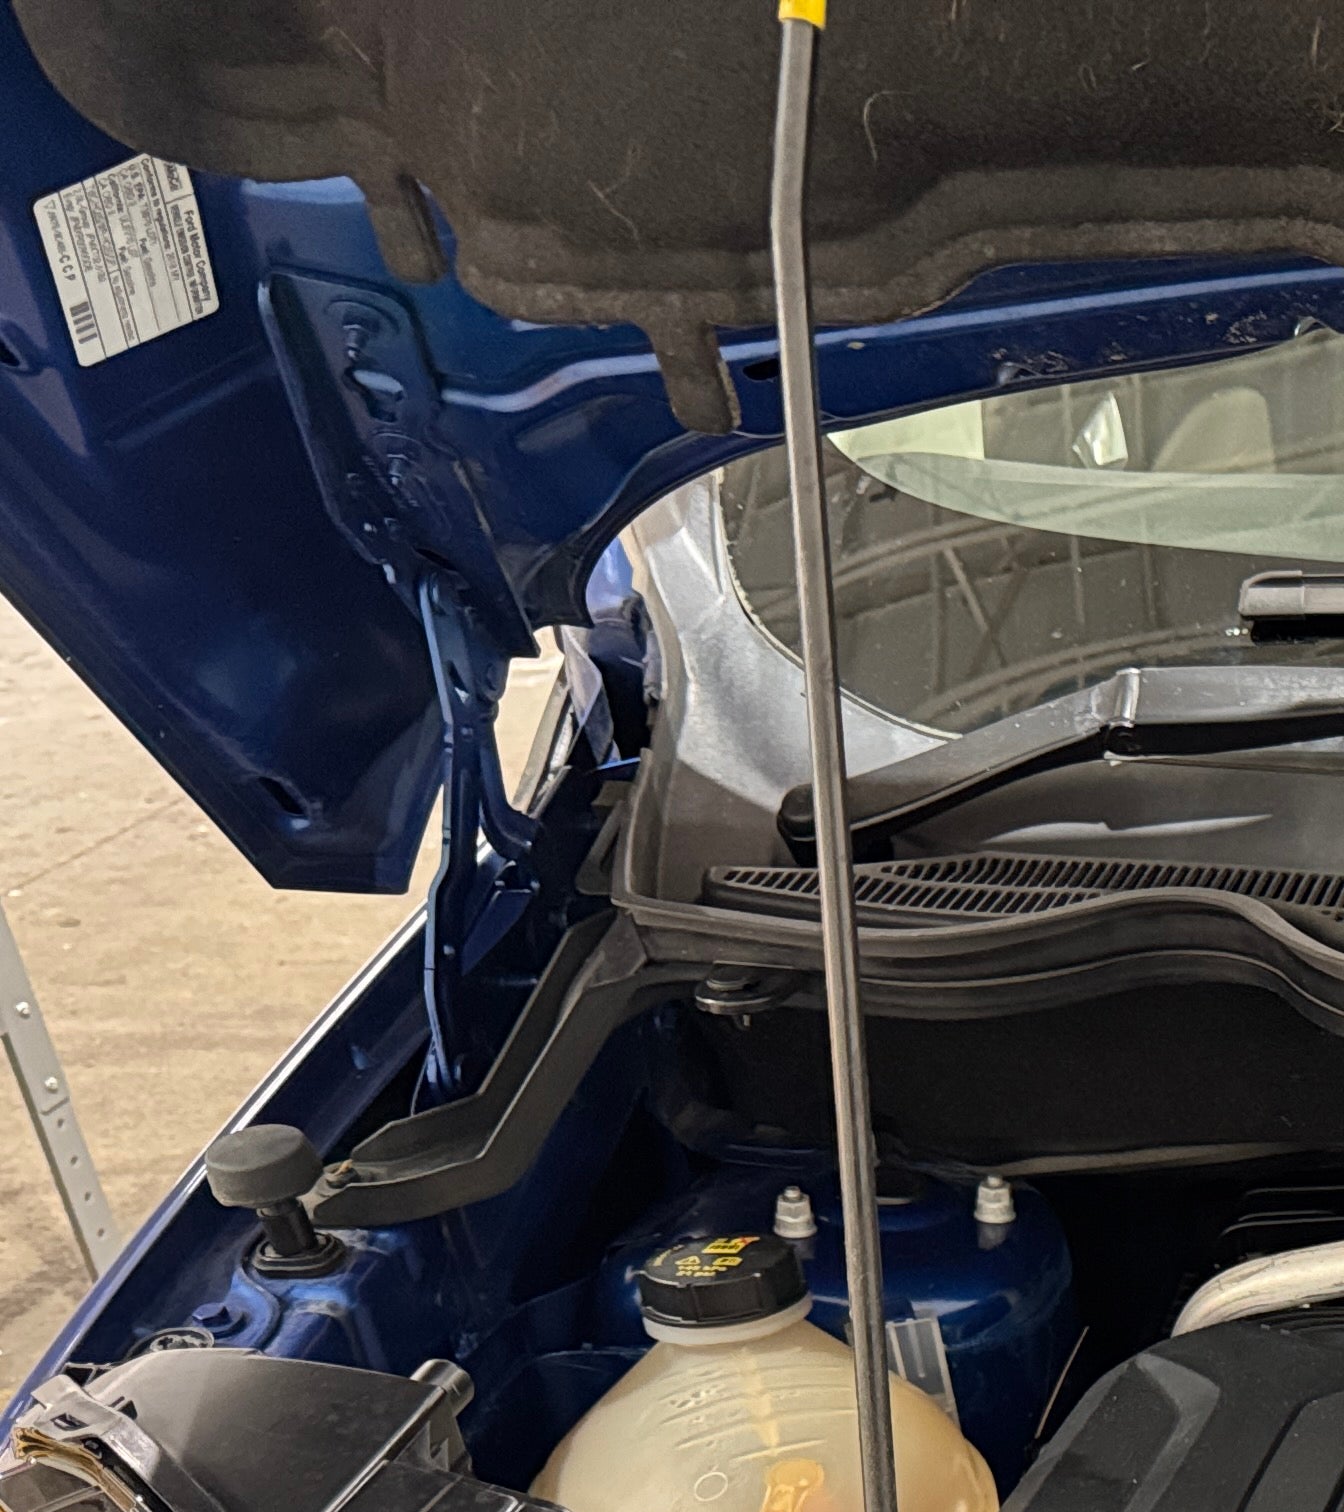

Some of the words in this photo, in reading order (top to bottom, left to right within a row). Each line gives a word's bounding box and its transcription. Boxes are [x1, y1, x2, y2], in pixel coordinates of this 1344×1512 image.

[140, 158, 158, 198] Conforms
[183, 210, 197, 233] Ford
[188, 233, 203, 259] Motor
[192, 260, 214, 302] Company
